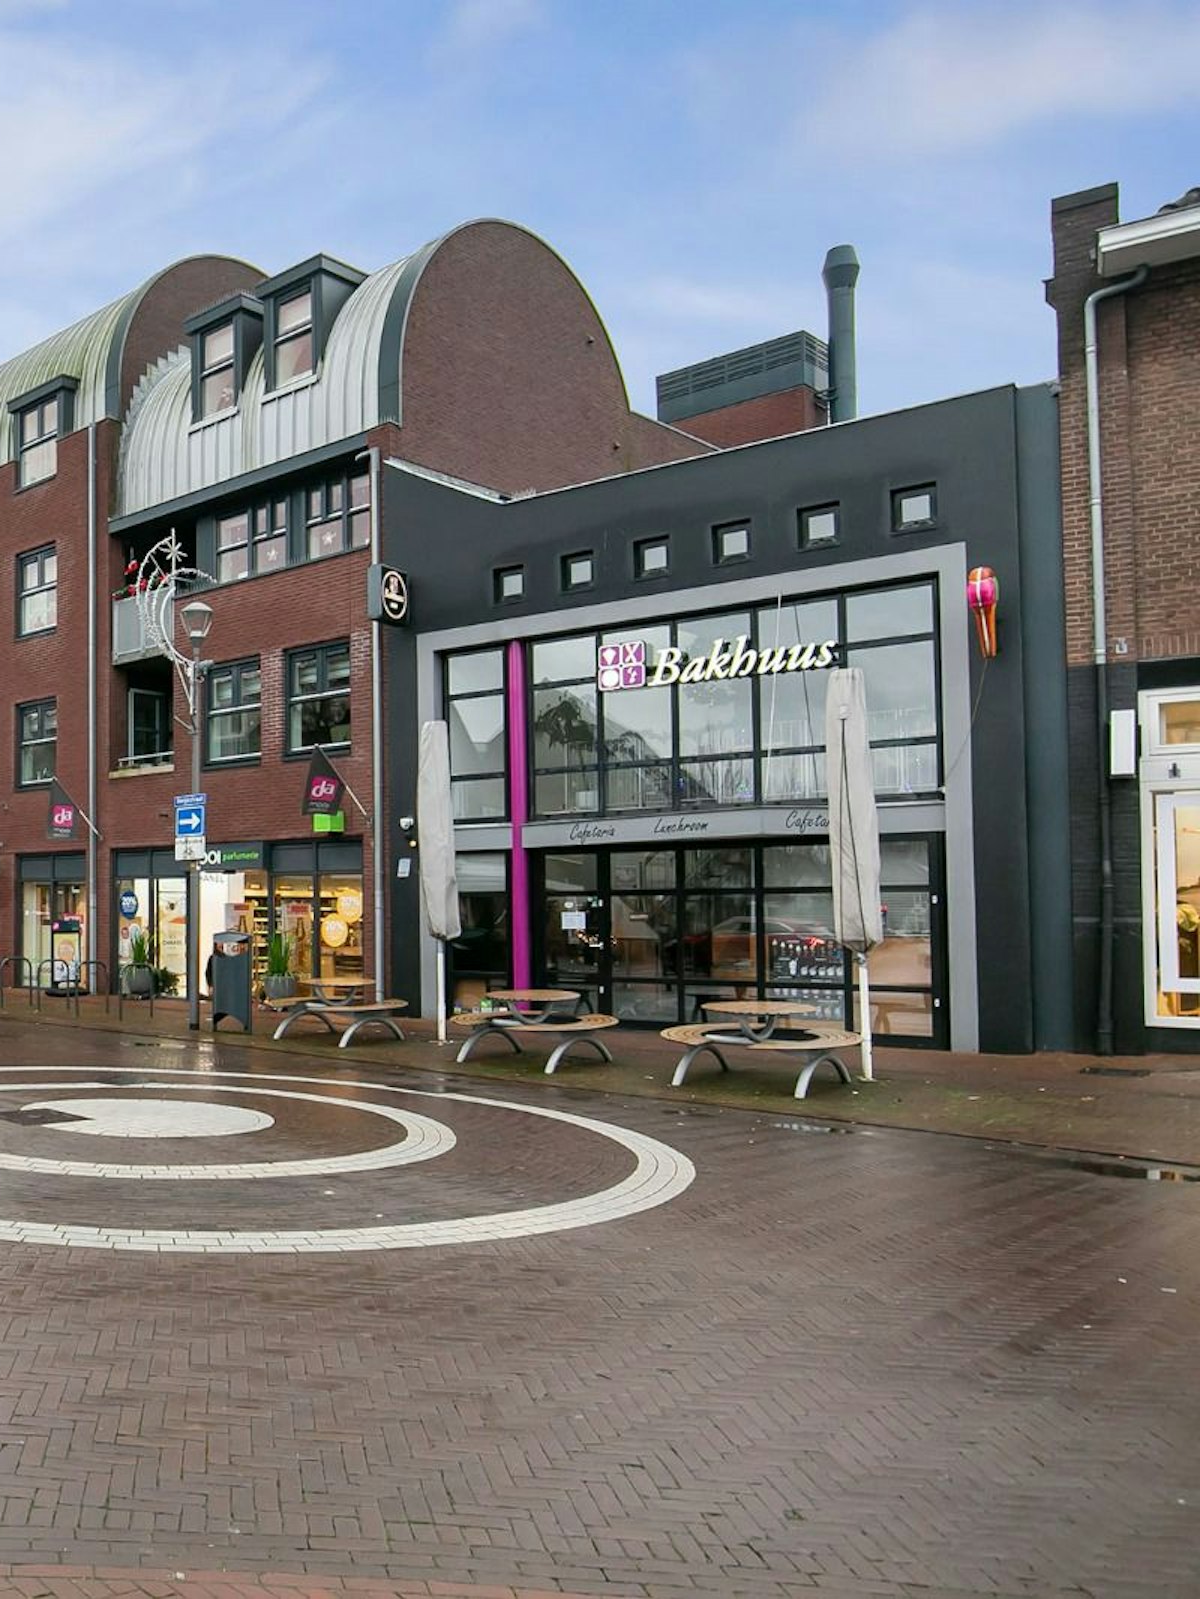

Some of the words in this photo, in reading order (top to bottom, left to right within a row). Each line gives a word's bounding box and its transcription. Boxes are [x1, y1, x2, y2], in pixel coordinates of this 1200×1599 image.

[648, 634, 837, 687] Bakhuus
[311, 781, 335, 797] da
[54, 808, 73, 825] da
[785, 810, 830, 833] Cafeta
[653, 817, 709, 834] Lunchroom
